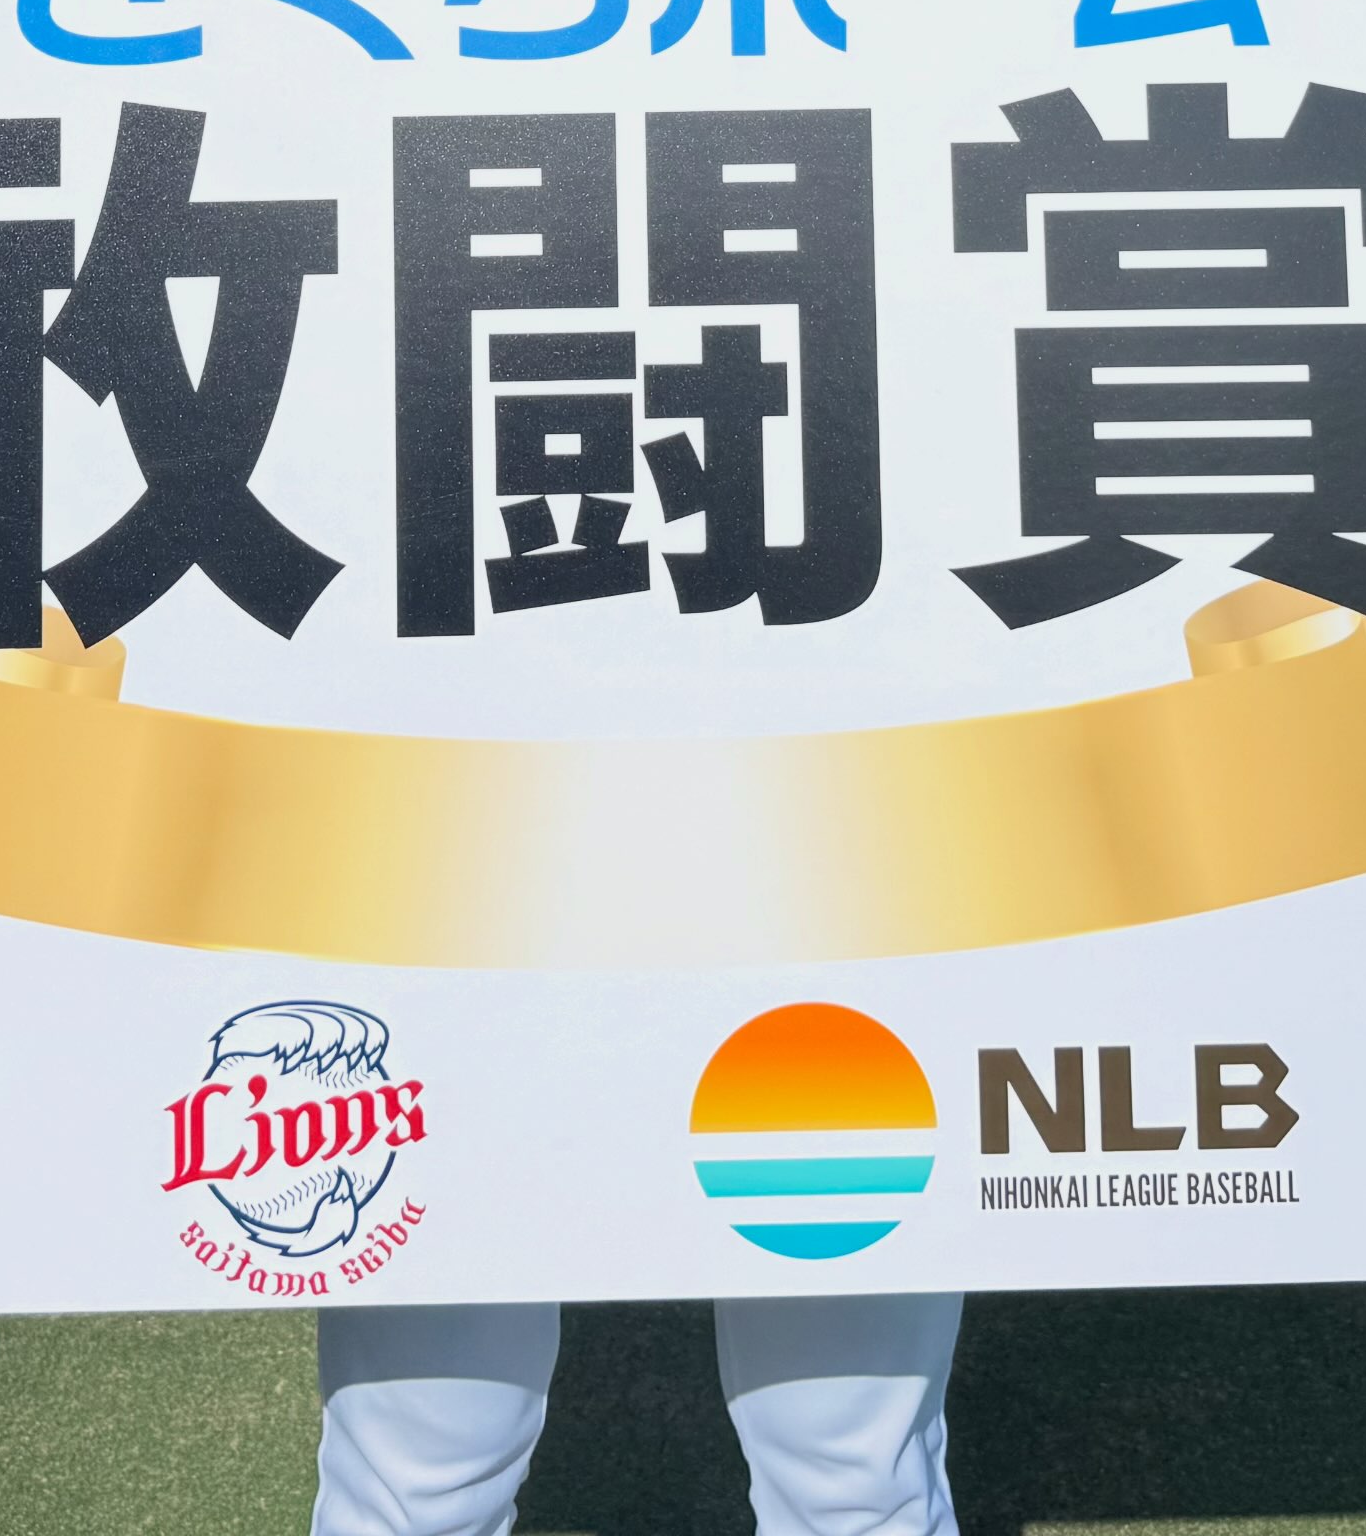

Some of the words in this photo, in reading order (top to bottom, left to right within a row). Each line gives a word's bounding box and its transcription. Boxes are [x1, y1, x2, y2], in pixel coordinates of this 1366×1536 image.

[161, 1073, 427, 1192] Lions
[978, 1043, 1300, 1155] NLB
[981, 1174, 1088, 1210] NIHONKAI
[1096, 1172, 1179, 1207] LEAGUE
[1187, 1169, 1300, 1205] BASEBALL
